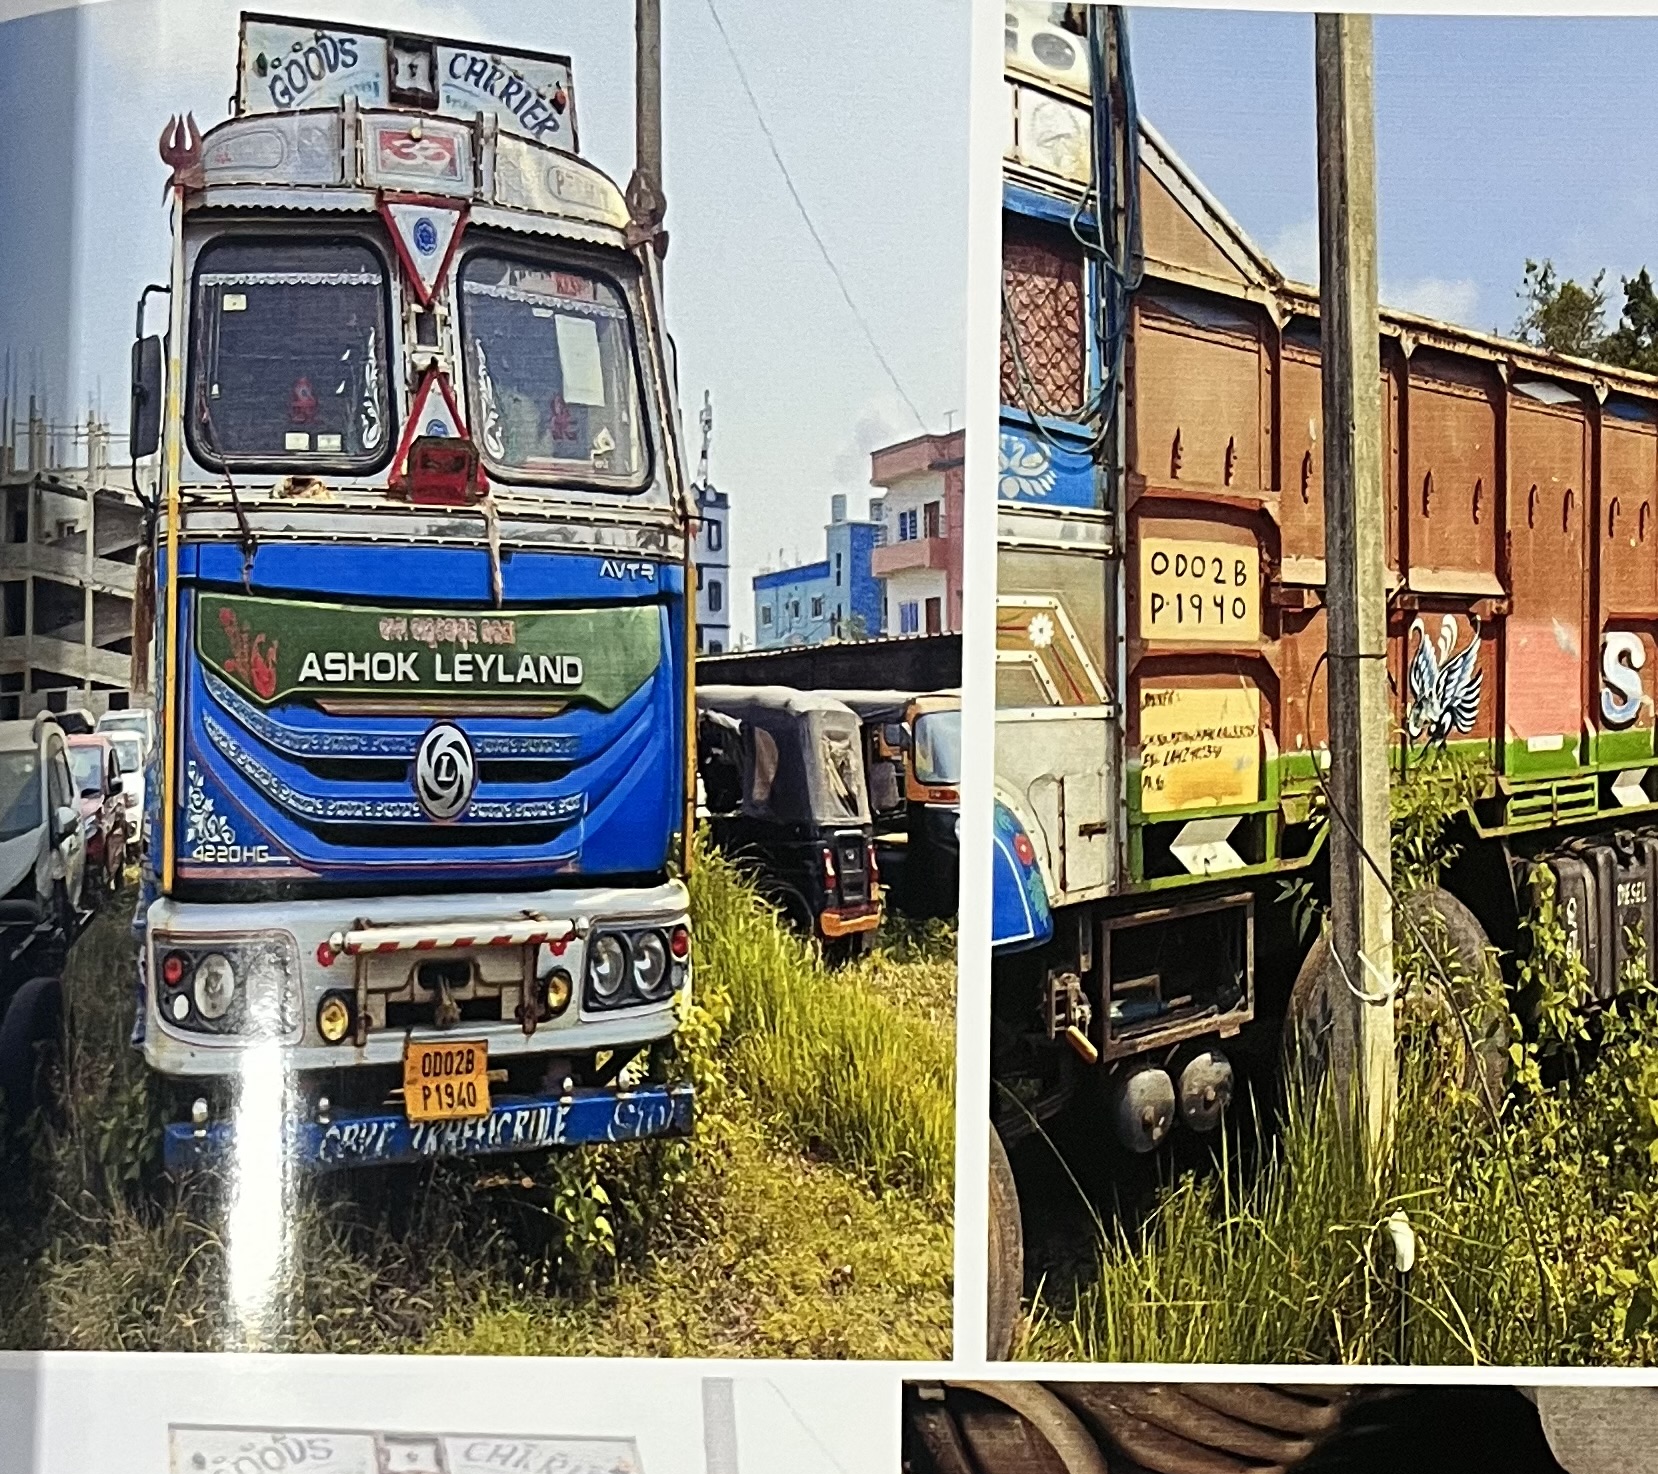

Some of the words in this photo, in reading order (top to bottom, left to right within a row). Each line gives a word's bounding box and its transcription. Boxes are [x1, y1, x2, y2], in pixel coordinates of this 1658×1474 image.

[268, 34, 358, 108] GOODS
[449, 53, 560, 139] CARRIER
[600, 560, 655, 580] AVTR
[299, 652, 419, 681] ASHOK
[435, 653, 583, 685] LEYLAND
[422, 1049, 474, 1077] OD02B
[422, 1082, 476, 1111] P1940
